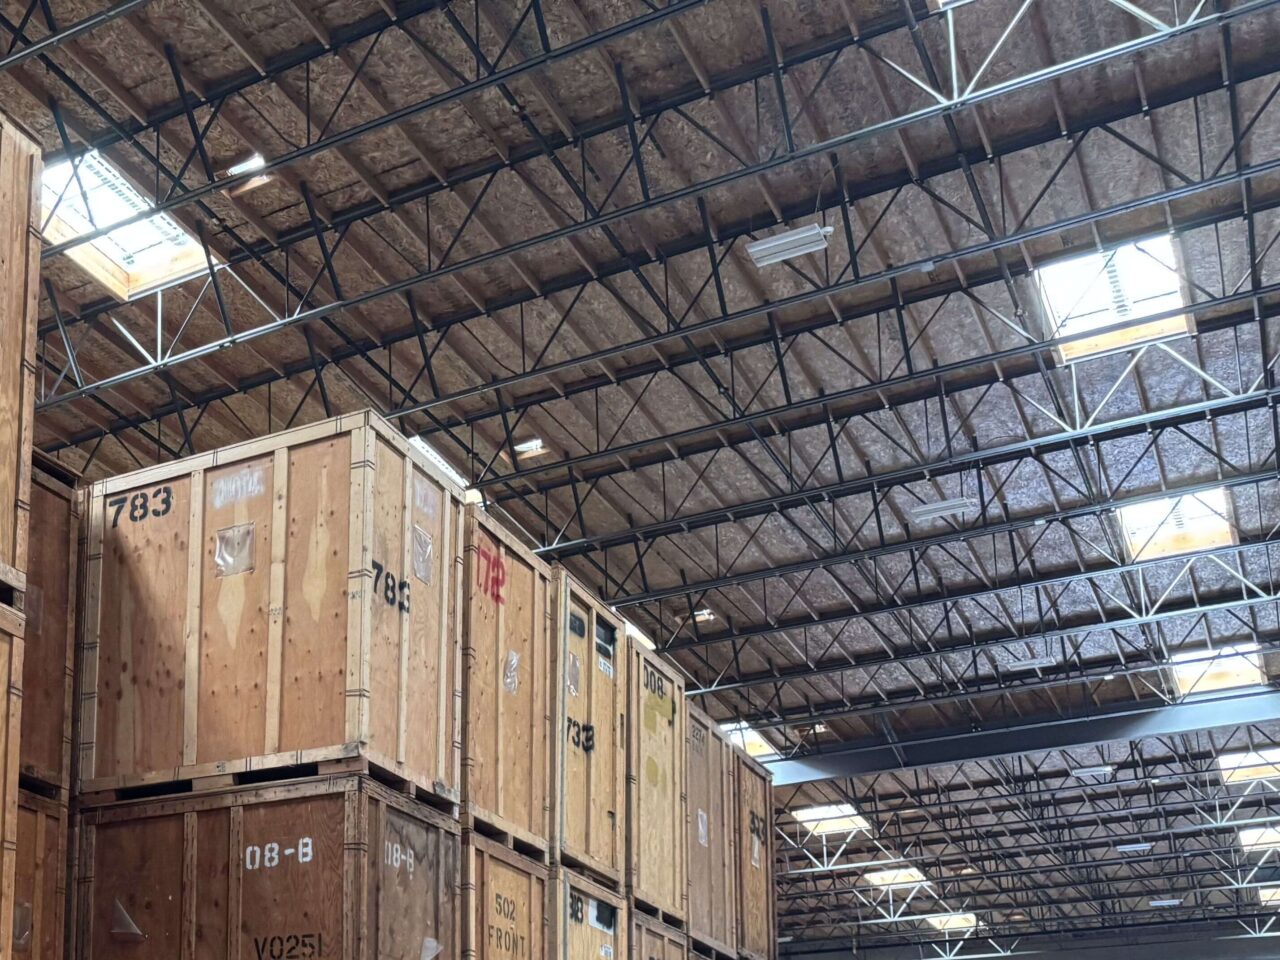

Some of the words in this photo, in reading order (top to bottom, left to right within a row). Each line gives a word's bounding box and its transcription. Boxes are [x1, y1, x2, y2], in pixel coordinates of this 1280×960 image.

[108, 486, 173, 528] 783
[245, 837, 314, 870] 08-B
[495, 893, 516, 922] 502
[488, 925, 525, 958] FRONT
